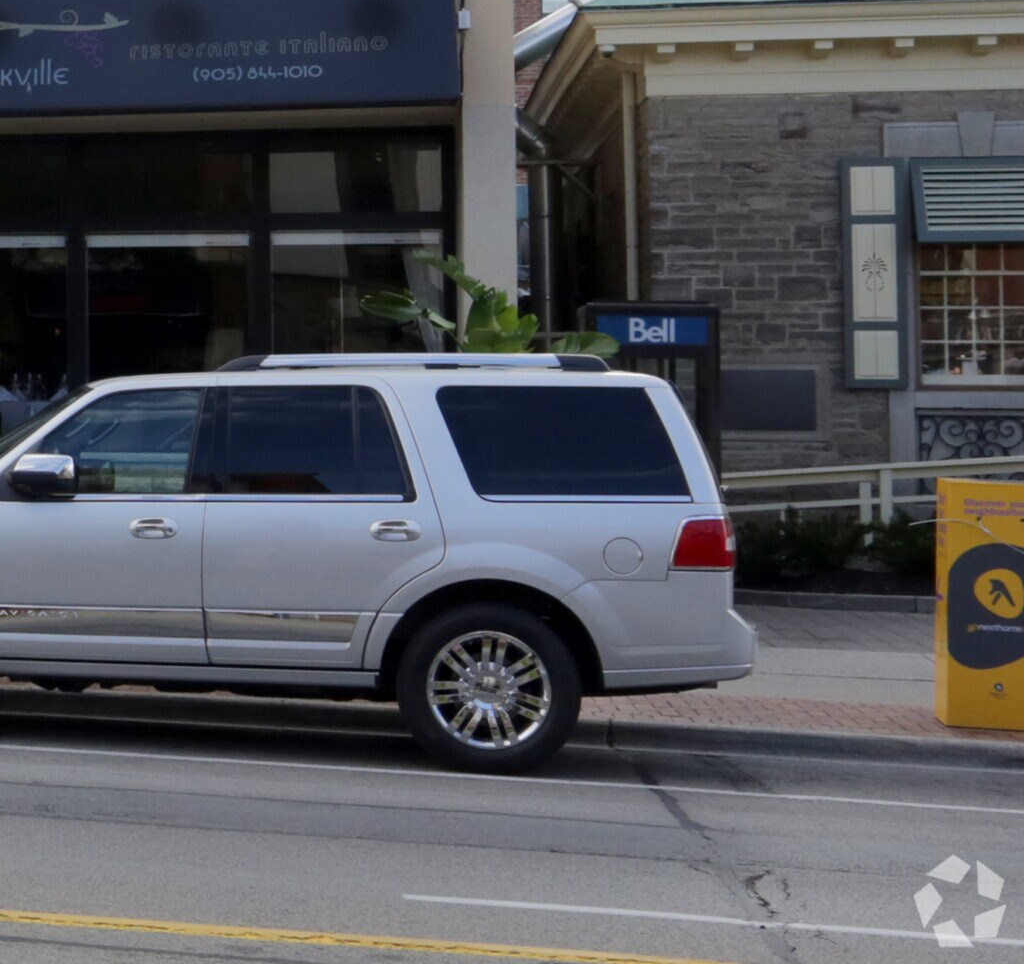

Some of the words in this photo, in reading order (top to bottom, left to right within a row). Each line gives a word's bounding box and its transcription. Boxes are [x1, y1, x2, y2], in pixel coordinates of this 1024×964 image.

[192, 66, 243, 83] (905)
[247, 64, 323, 80] 844-1010
[629, 317, 675, 343] Bell
